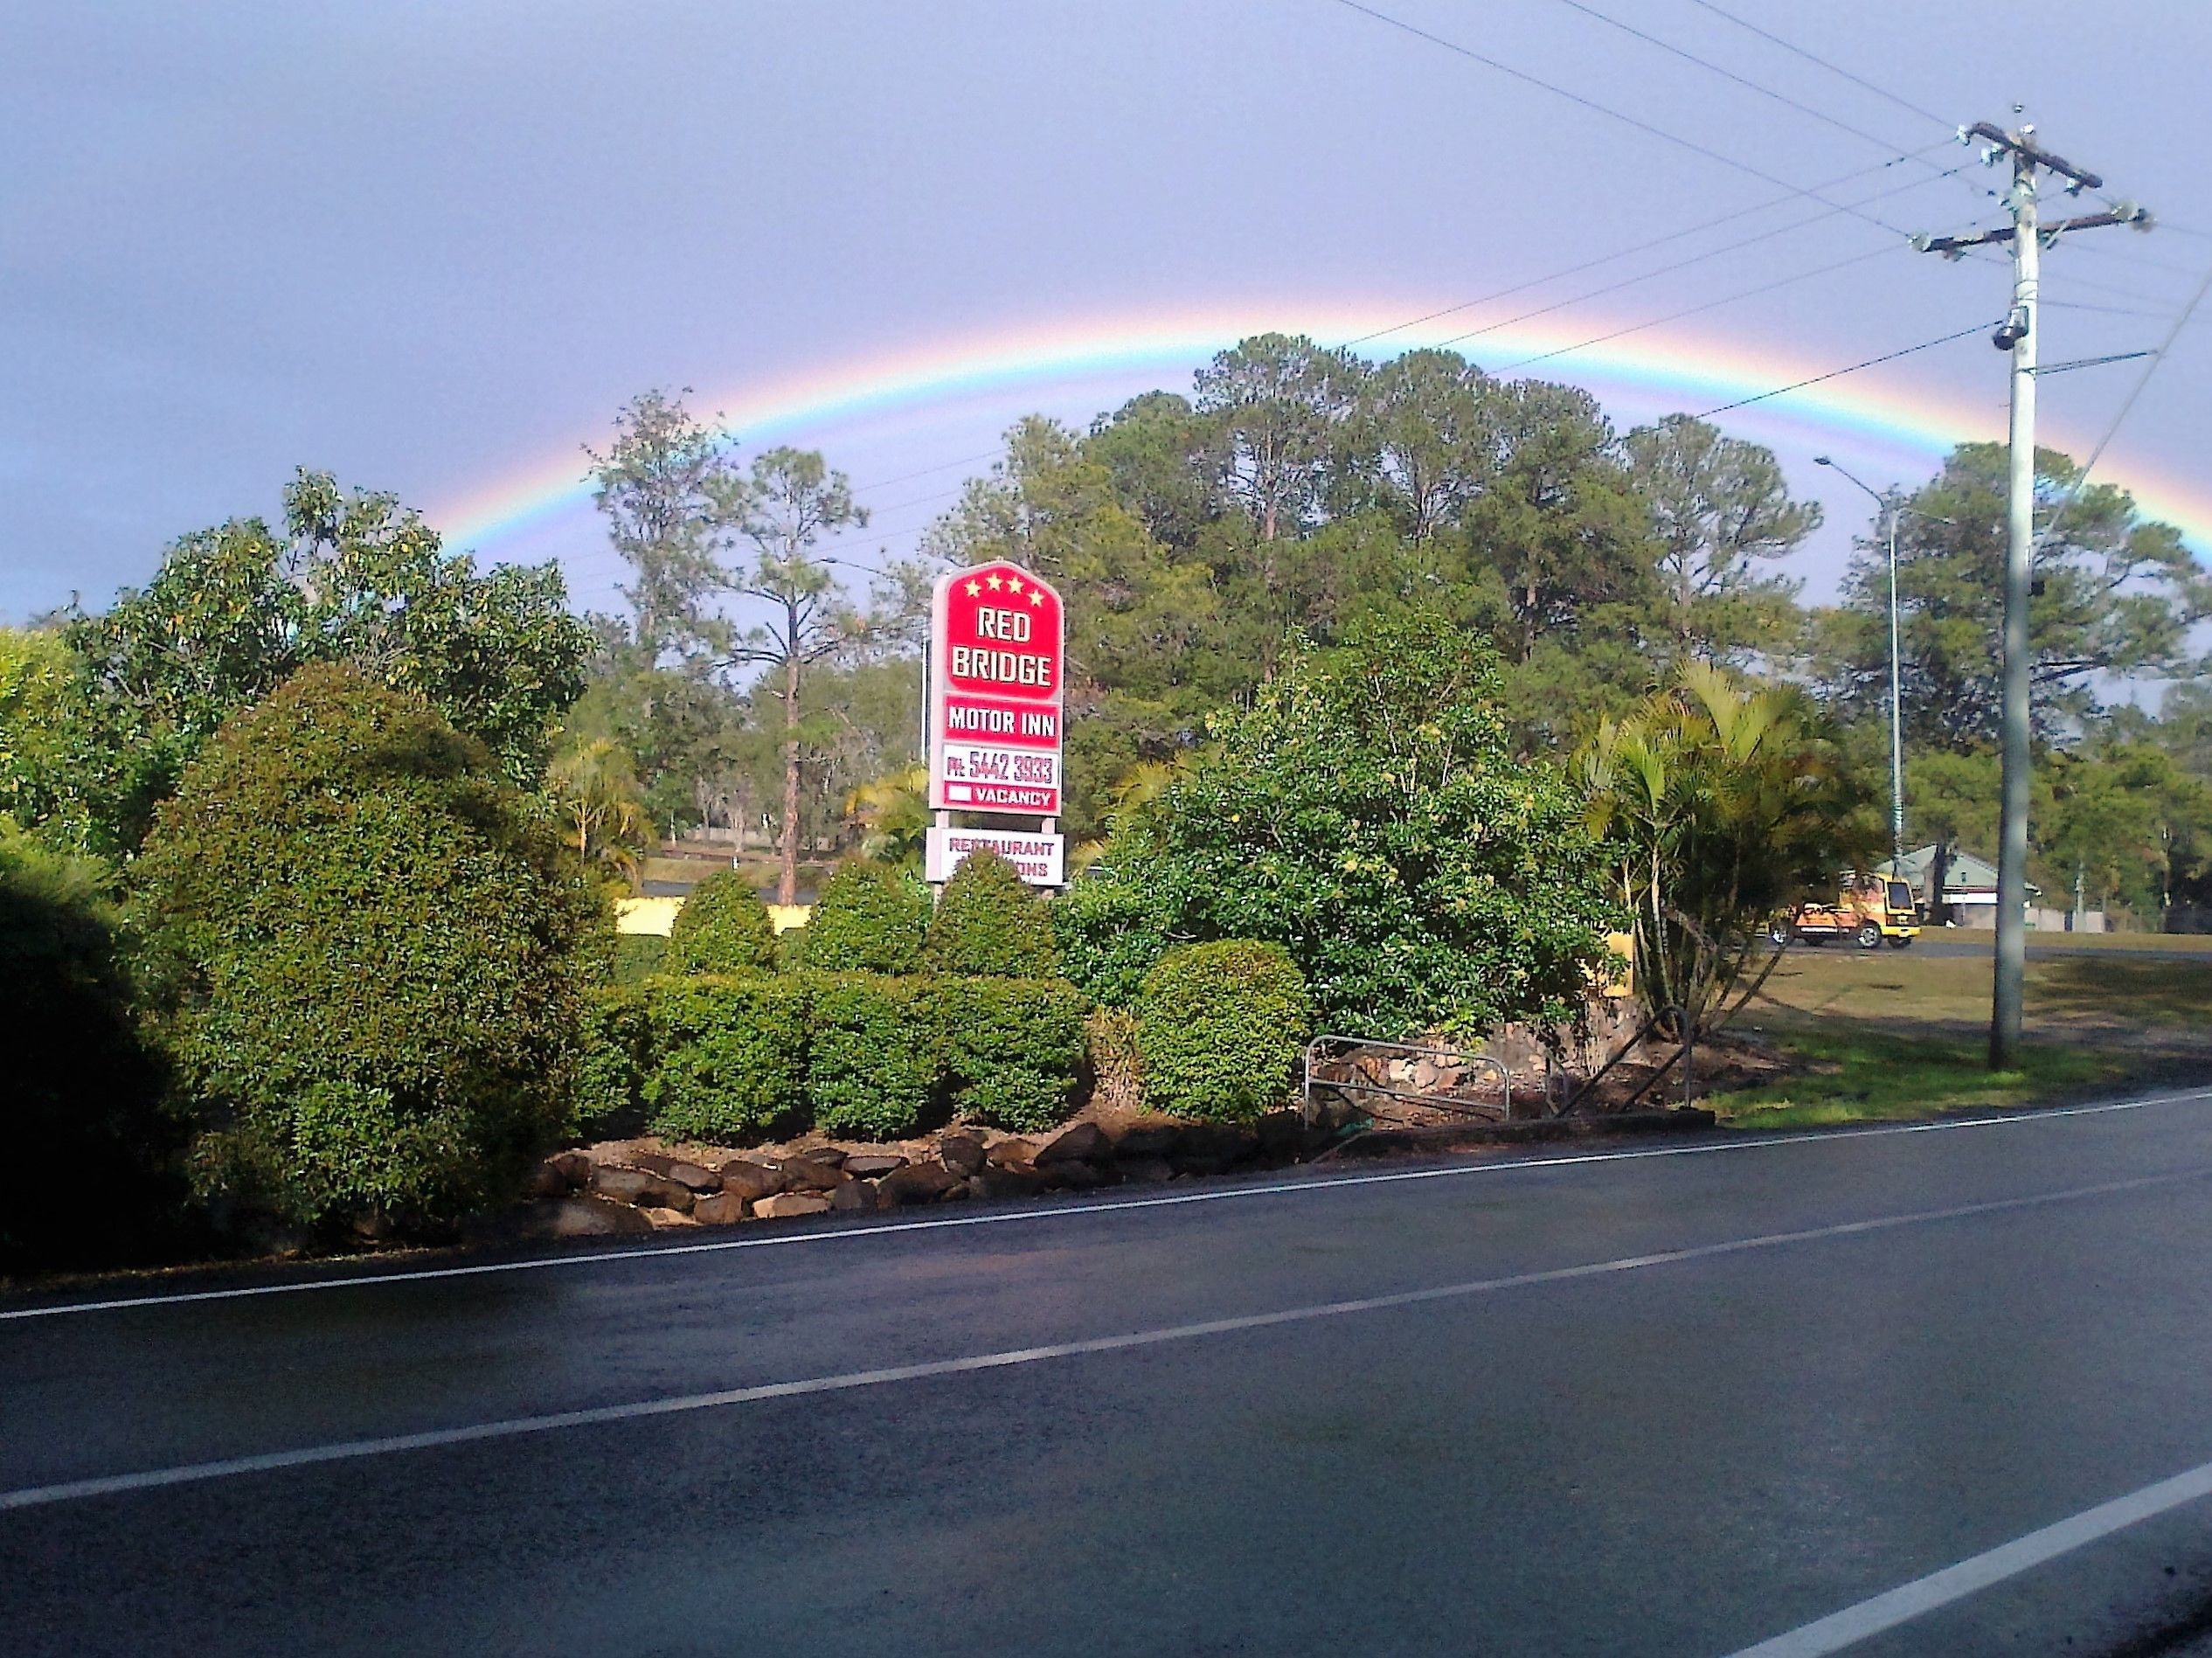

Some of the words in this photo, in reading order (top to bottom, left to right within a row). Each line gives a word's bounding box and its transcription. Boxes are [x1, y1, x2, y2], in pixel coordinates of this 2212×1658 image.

[977, 606, 1031, 642] RED
[952, 645, 1052, 687] BRIDGE
[948, 706, 1015, 734] MOTOR
[1021, 712, 1056, 738] INN
[970, 752, 1009, 780] 5442
[1014, 756, 1052, 784] 3933
[976, 787, 1051, 807] VACANCY
